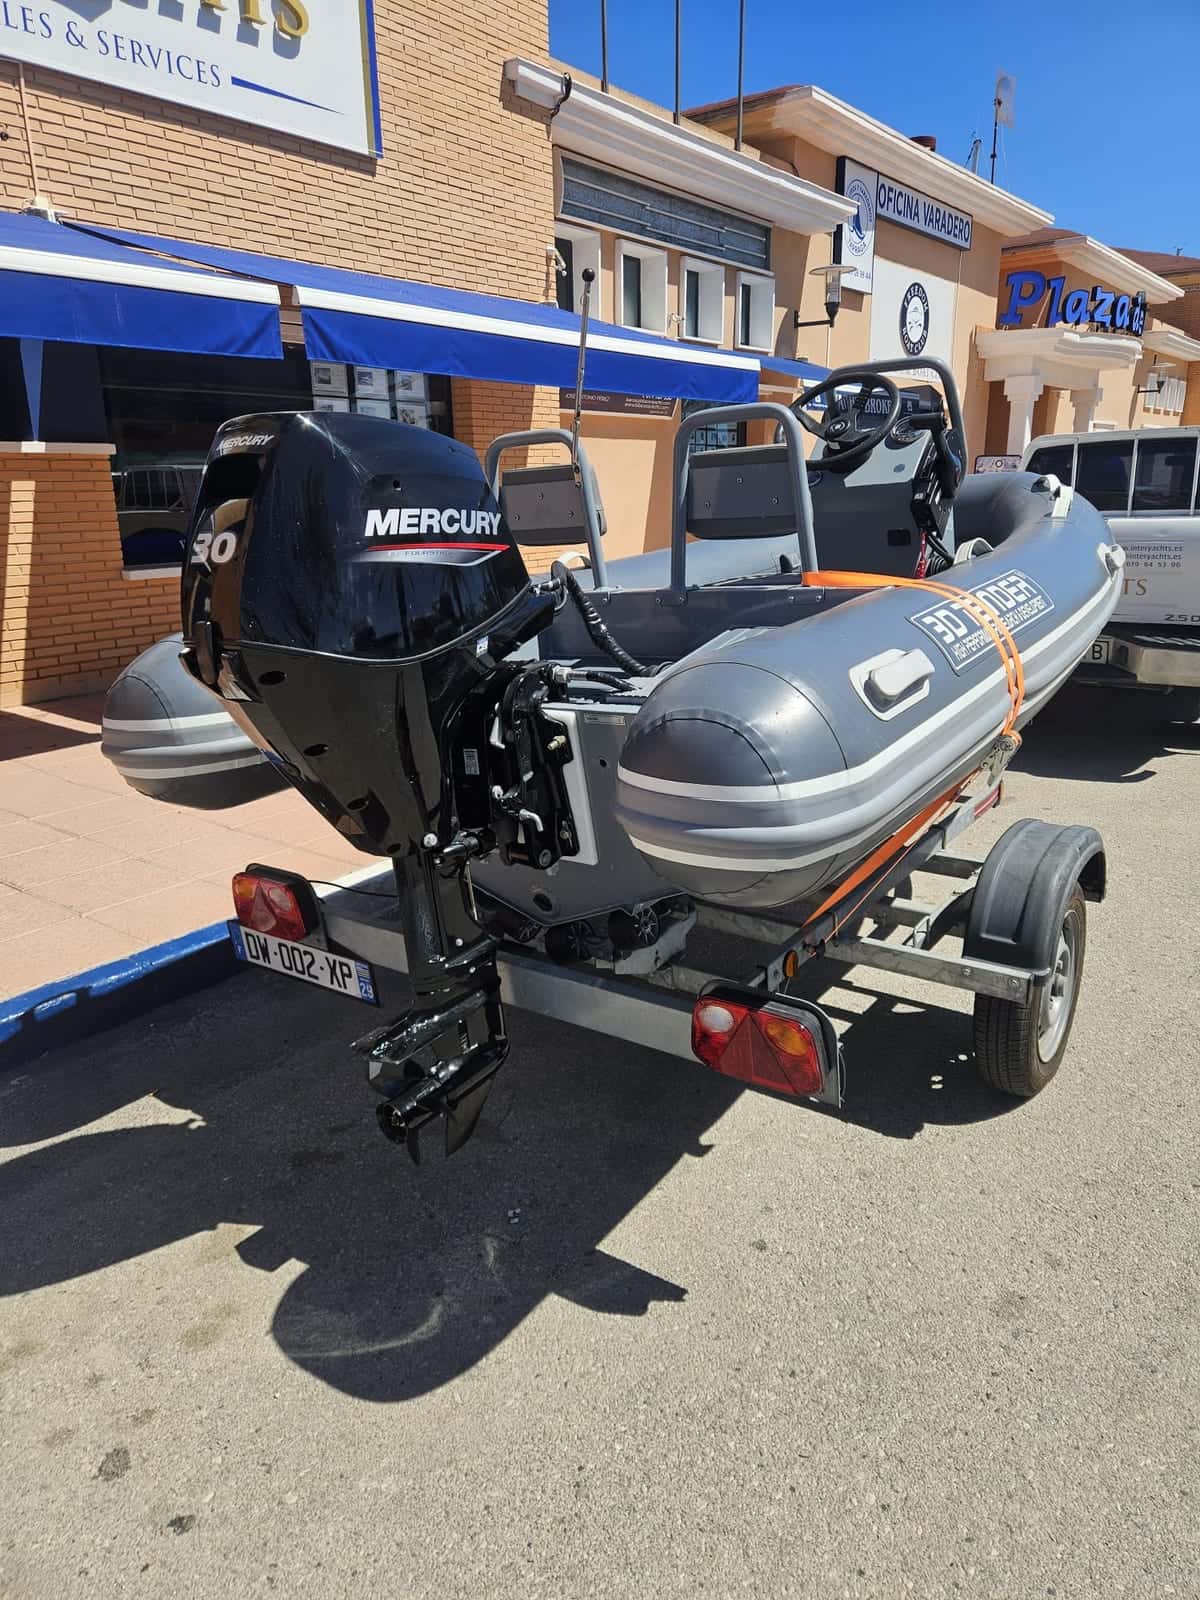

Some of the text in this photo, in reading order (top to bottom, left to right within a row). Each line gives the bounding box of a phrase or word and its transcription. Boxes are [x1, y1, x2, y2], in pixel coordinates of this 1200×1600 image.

[65, 20, 88, 49] &
[97, 30, 221, 88] SERVICES
[878, 183, 920, 224] OFICINA
[923, 201, 971, 243] VARADERO
[999, 270, 1131, 328] Plaza
[216, 434, 275, 452] MERCURY
[364, 508, 502, 537] MERCURY
[190, 531, 238, 564] 30
[922, 608, 968, 644] 3D
